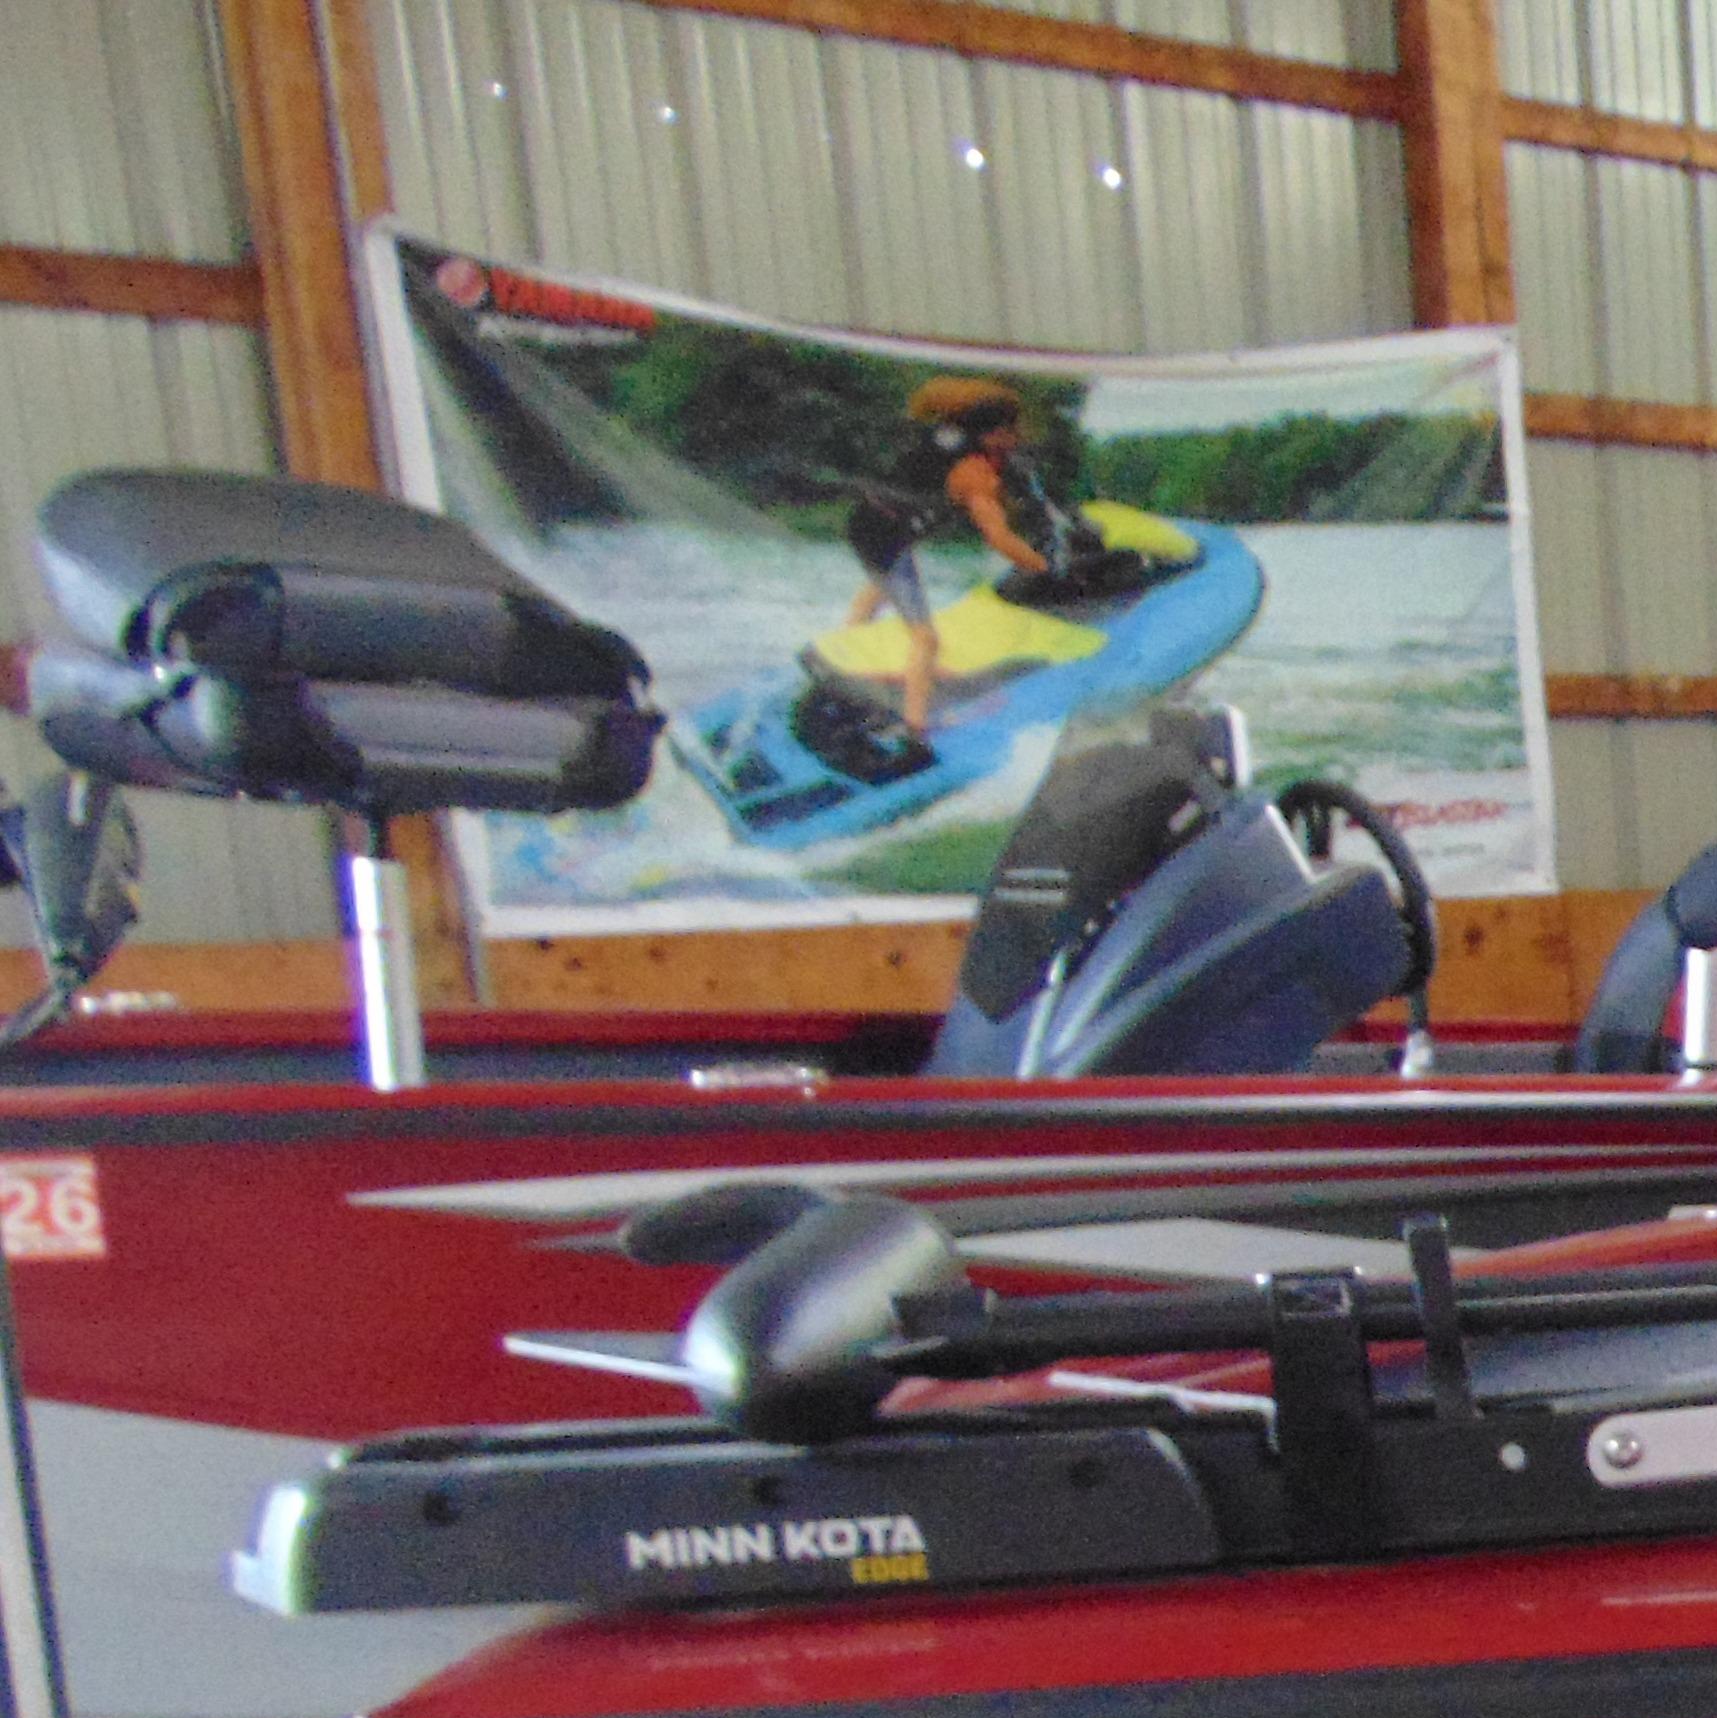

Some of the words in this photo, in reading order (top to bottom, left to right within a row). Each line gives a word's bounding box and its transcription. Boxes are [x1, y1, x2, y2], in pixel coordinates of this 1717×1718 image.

[0, 1180, 98, 1237] 26
[624, 1523, 774, 1571] MINN
[781, 1514, 927, 1560] KOTA
